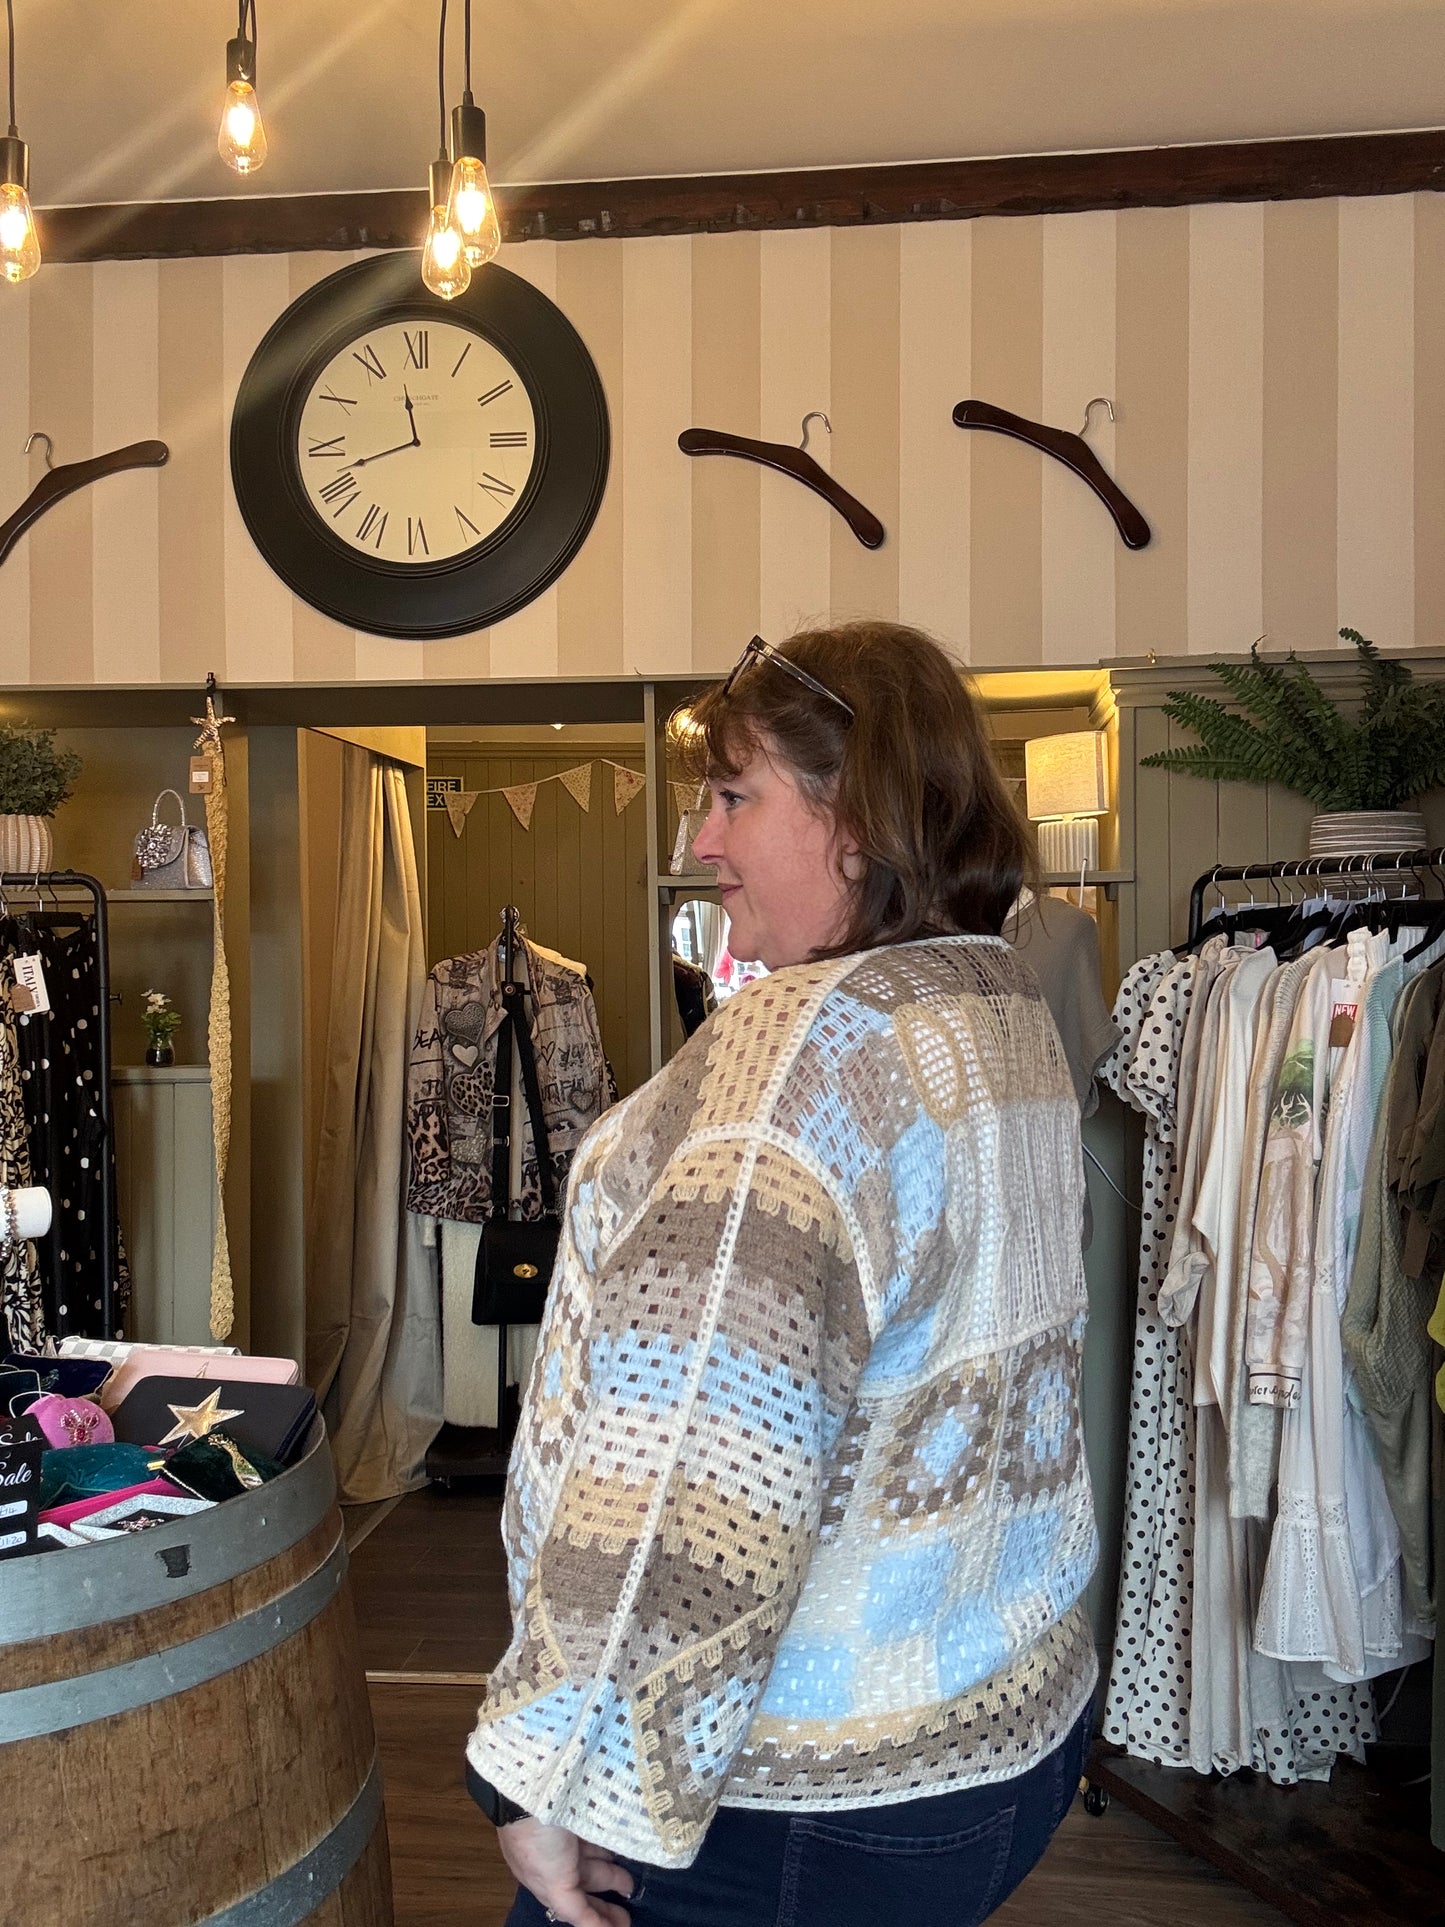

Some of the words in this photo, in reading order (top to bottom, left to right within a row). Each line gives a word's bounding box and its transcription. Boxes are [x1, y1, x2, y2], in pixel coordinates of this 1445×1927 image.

[352, 344, 388, 387] XI
[403, 330, 429, 371] XII
[451, 342, 472, 378] I
[319, 384, 358, 416] X
[392, 394, 439, 402] CHCHGATE
[477, 379, 514, 408] II
[308, 435, 346, 458] IX
[489, 431, 528, 448] III
[319, 471, 362, 518] VIII
[477, 472, 516, 509] IV
[355, 503, 389, 549] VII
[407, 517, 430, 556] VI
[454, 505, 481, 543] V
